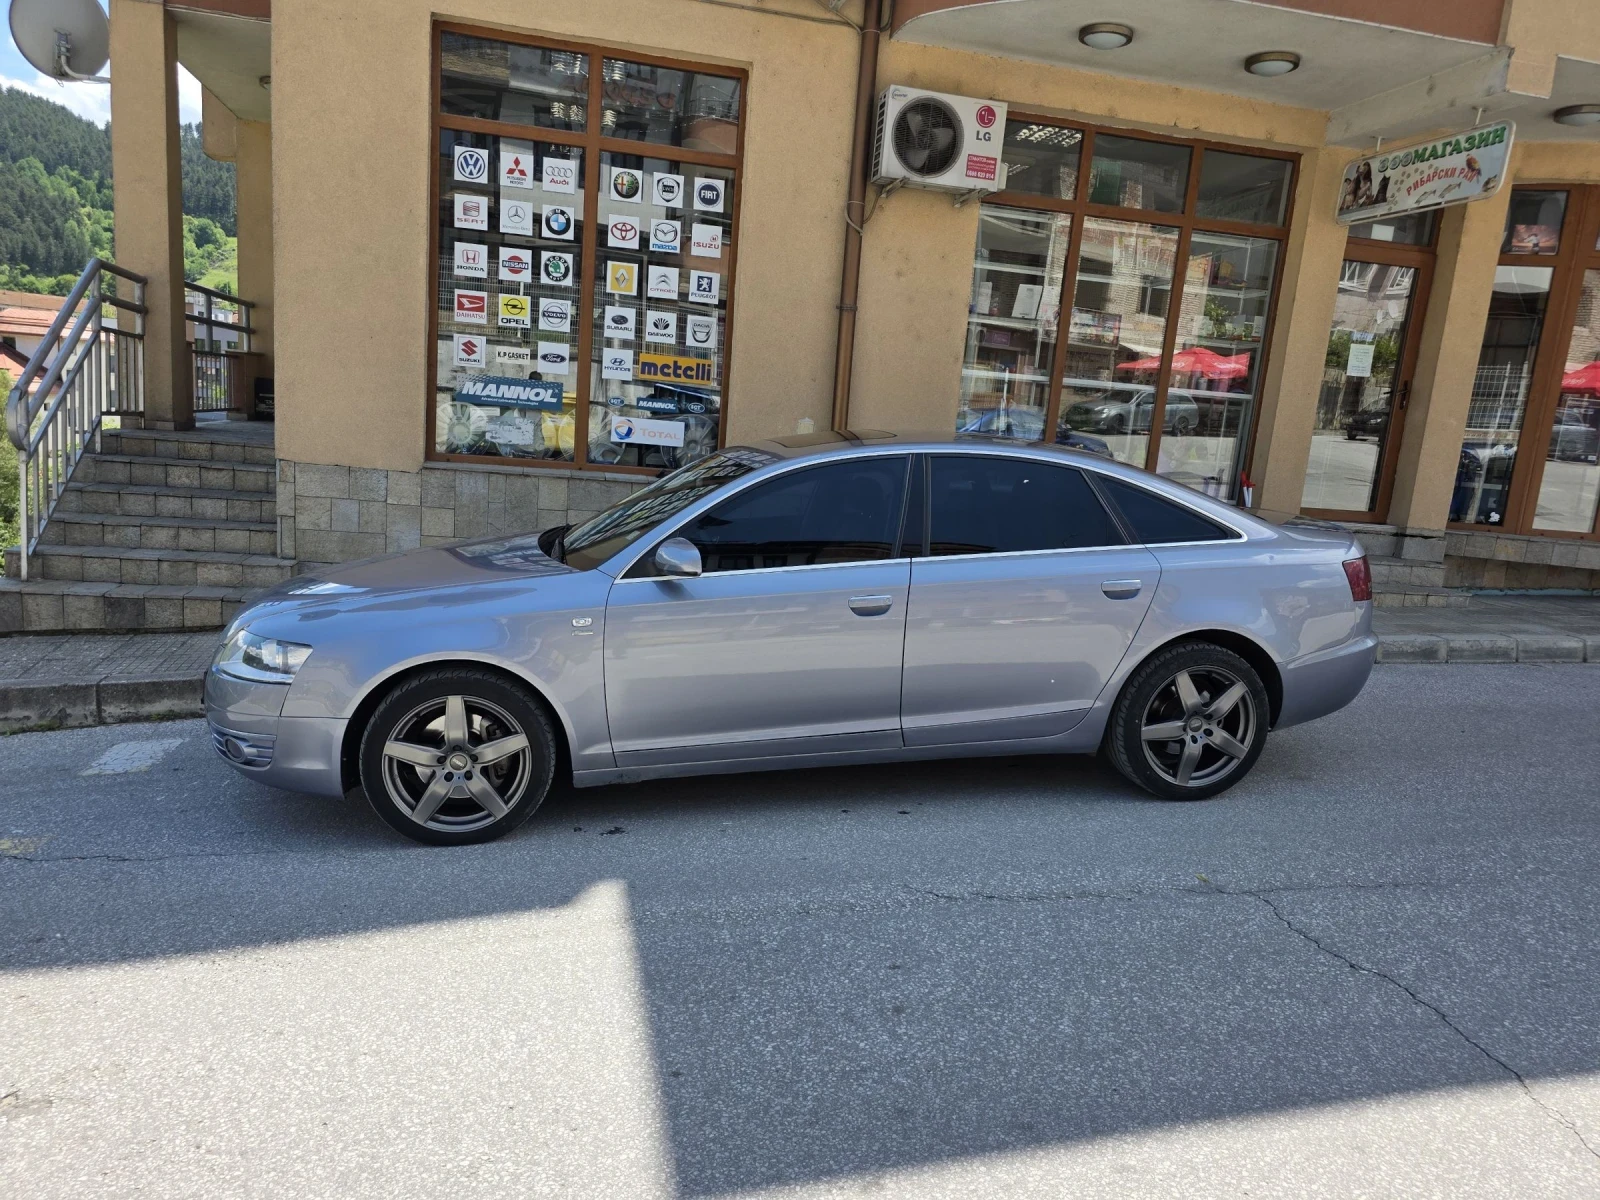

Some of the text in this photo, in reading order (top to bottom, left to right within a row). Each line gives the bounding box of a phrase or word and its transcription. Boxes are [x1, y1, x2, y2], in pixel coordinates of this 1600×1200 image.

[976, 131, 991, 142] LG
[1377, 126, 1507, 173] ЗООМАГАЗИН
[1406, 166, 1457, 197] РИБАРСКИ
[700, 190, 717, 200] FIAT
[548, 208, 569, 219] BMW
[456, 217, 485, 225] SEAT
[693, 241, 719, 249] ISUZU
[502, 261, 528, 269] NISSAN
[456, 312, 486, 320] DAIHATSU
[501, 317, 528, 326] OPEL
[507, 351, 529, 360] GASKET
[545, 353, 561, 363] Ford
[640, 360, 711, 382] metelli
[462, 381, 557, 403] MANNOL
[638, 400, 676, 410] MANNOL
[640, 428, 680, 440] TOTAL
